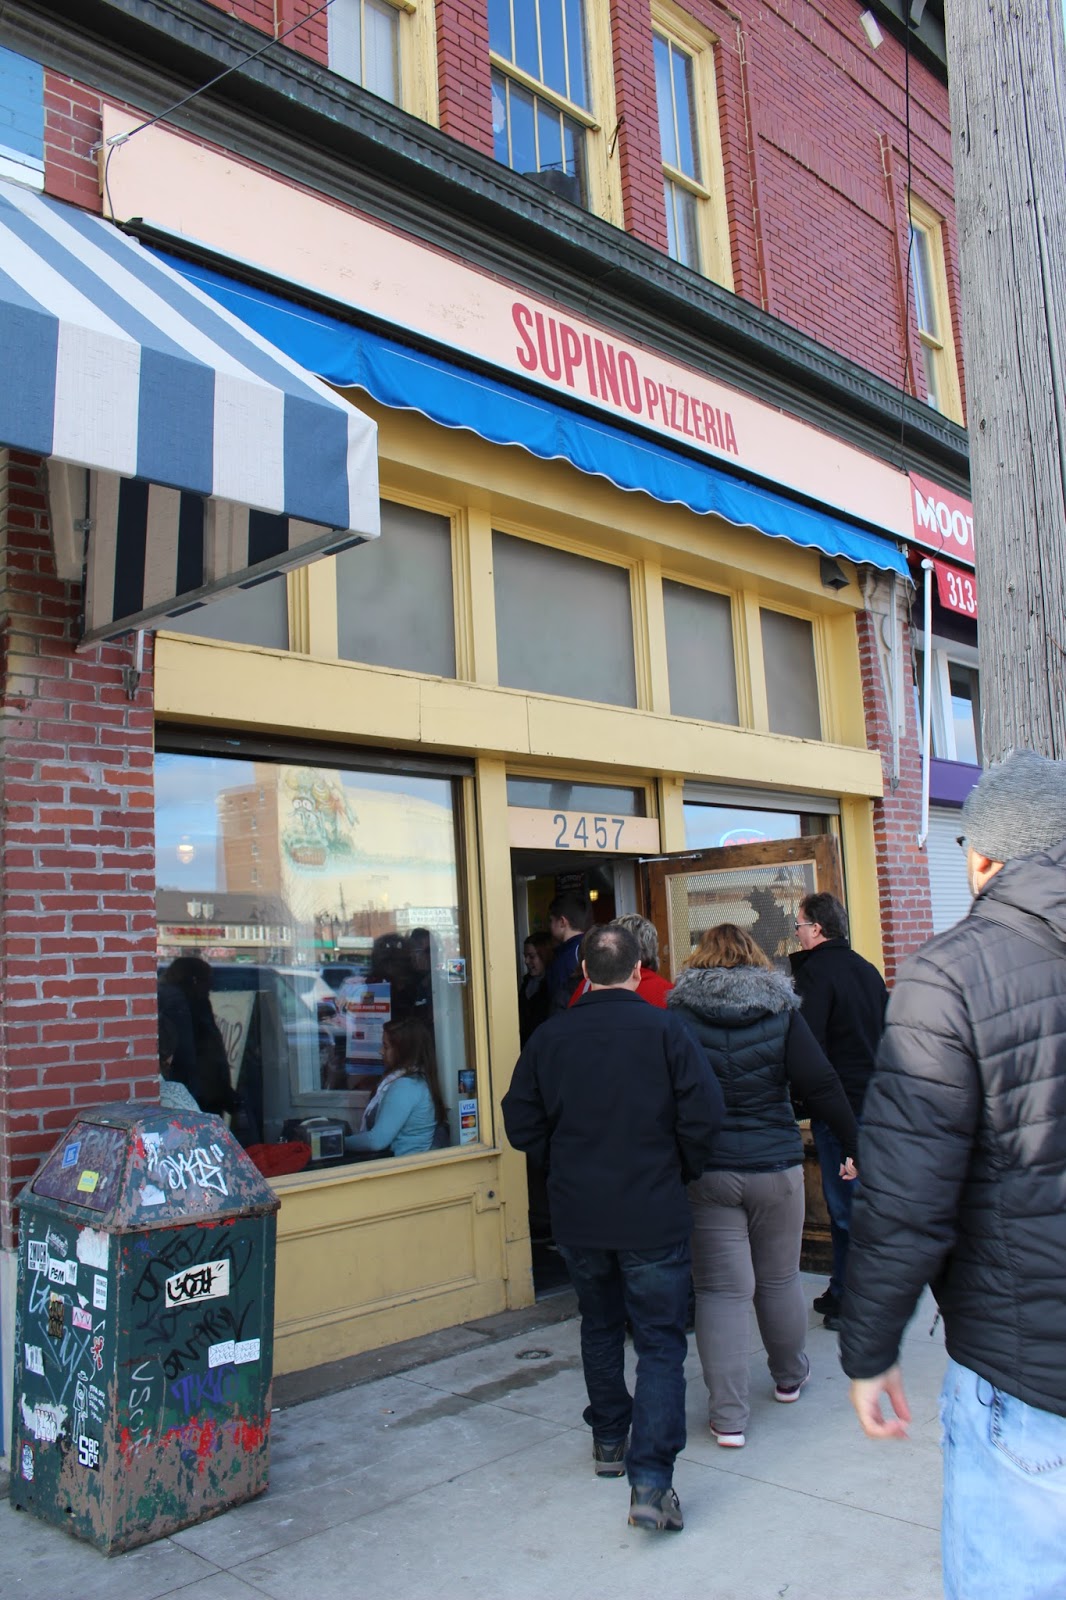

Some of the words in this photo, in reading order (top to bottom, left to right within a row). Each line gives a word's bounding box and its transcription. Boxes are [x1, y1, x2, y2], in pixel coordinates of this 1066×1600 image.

[511, 302, 643, 415] SUPINO
[643, 376, 739, 456] PIZZERIA
[553, 814, 625, 850] 2457
